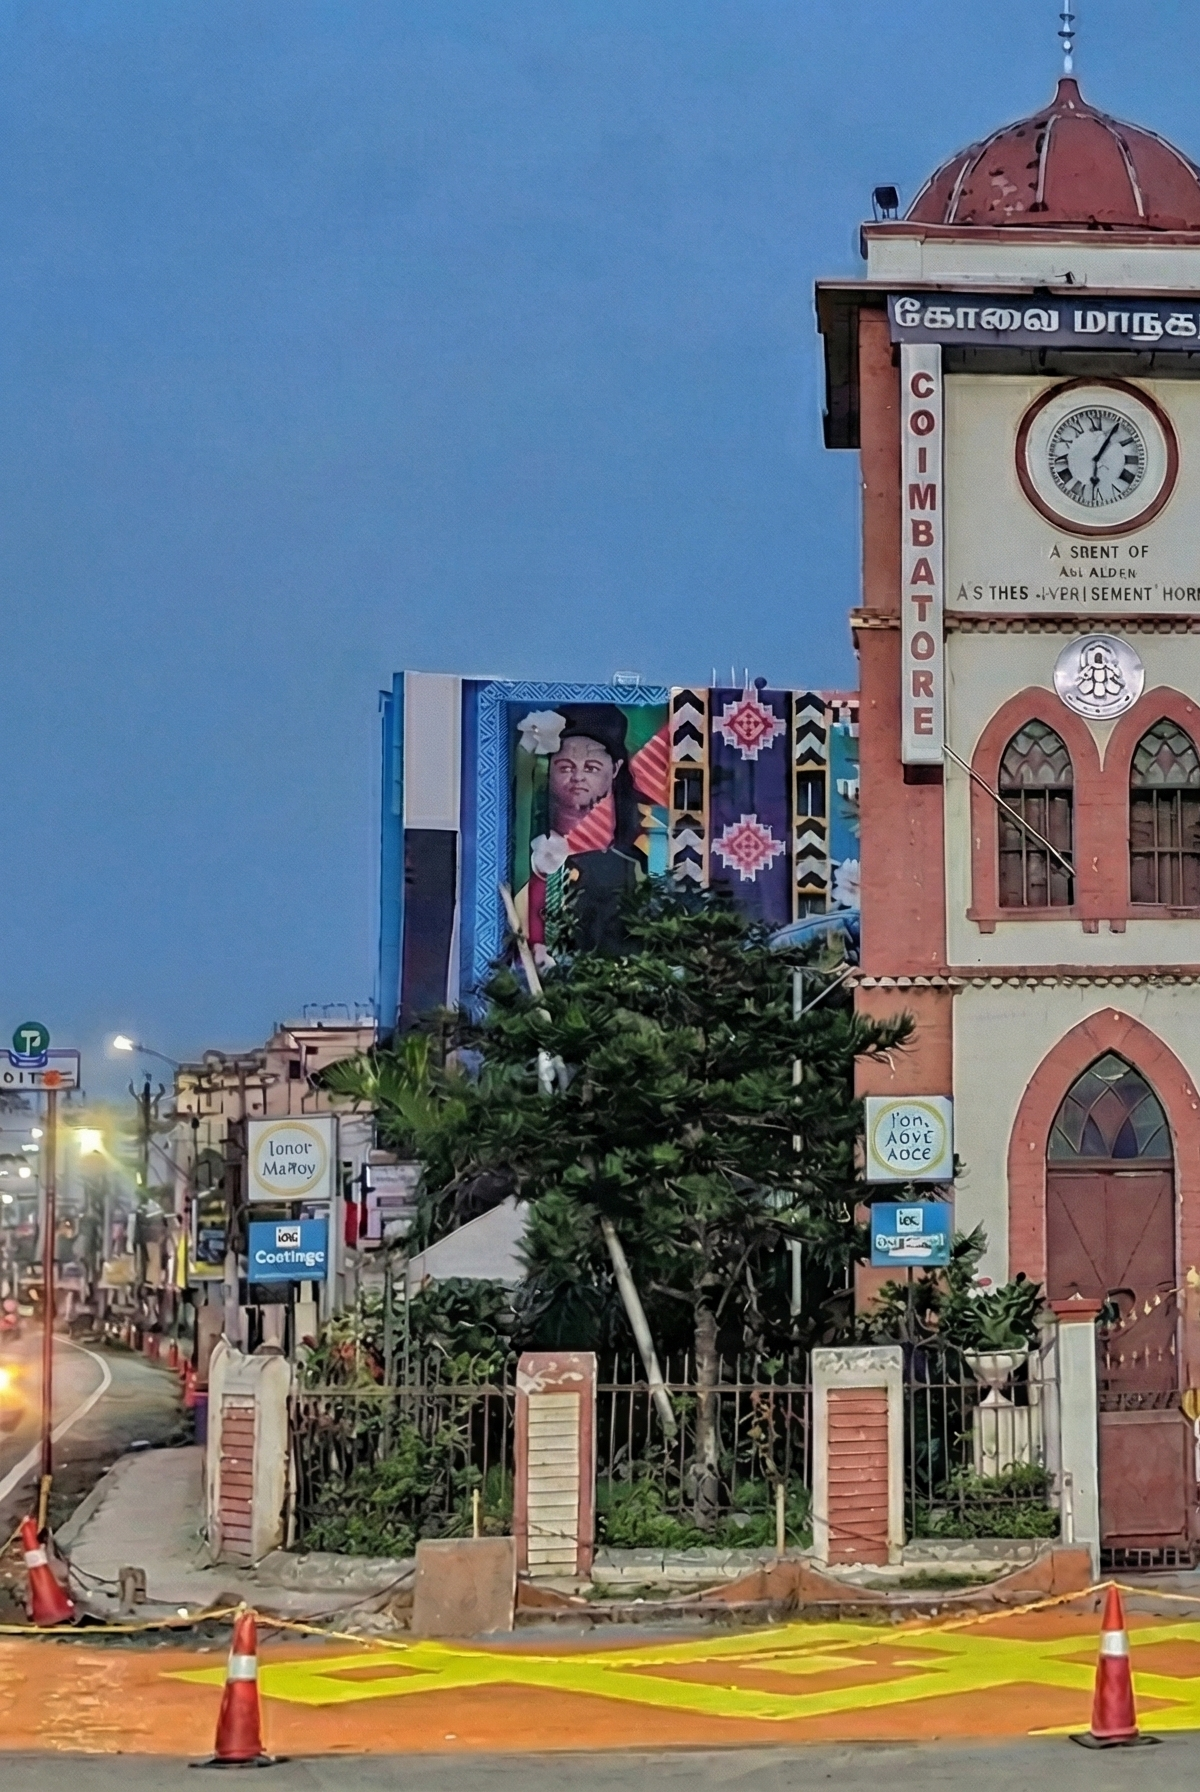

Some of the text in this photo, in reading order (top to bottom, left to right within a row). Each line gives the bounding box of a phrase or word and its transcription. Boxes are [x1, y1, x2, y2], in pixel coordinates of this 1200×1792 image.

[908, 371, 937, 735] COIMBATORE
[1049, 544, 1061, 559] A
[1128, 545, 1149, 558] OF
